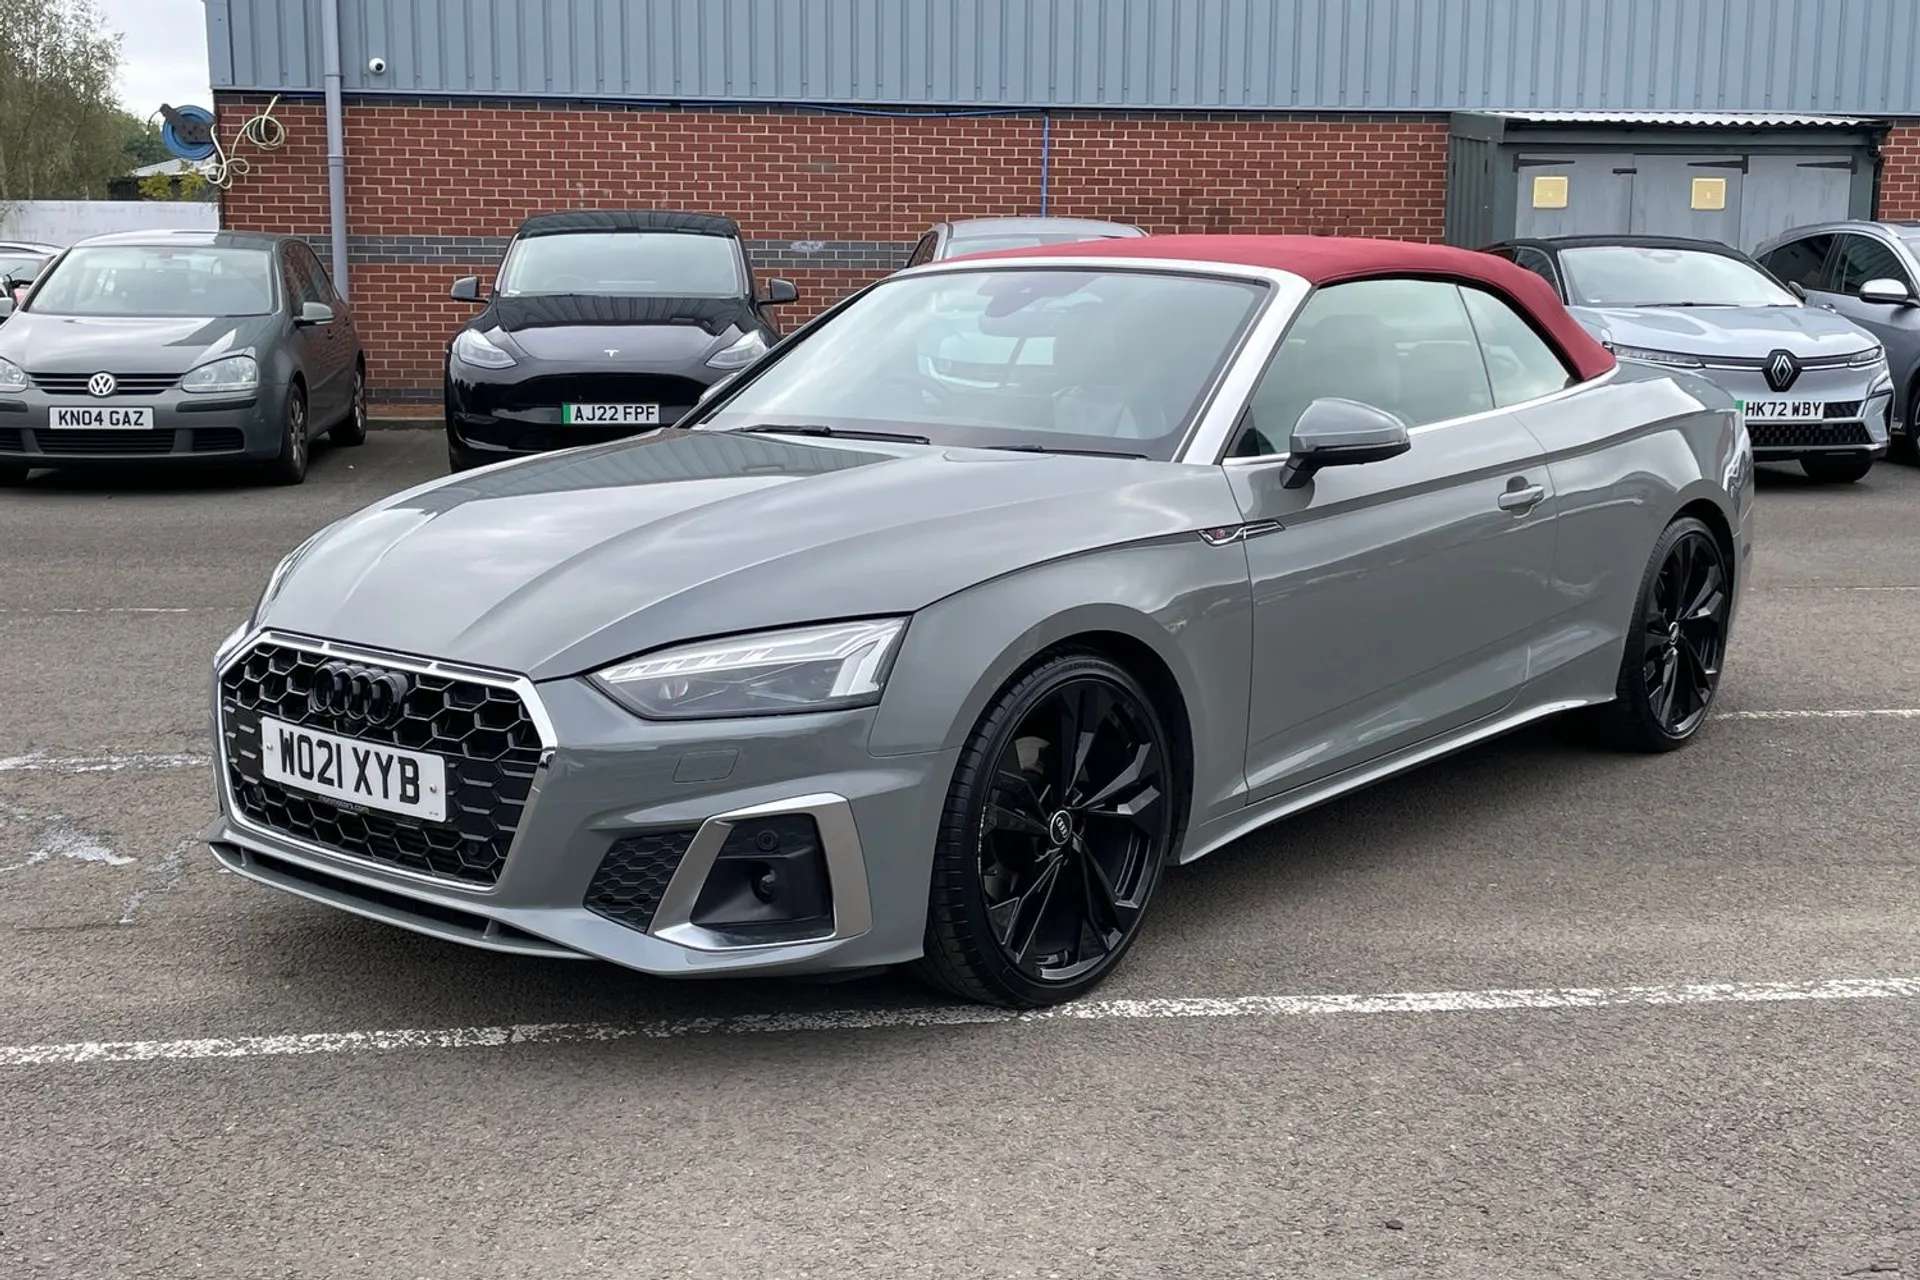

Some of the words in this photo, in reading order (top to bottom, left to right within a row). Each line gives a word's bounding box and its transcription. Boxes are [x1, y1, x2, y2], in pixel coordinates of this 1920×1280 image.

[58, 409, 104, 426] KN04
[109, 409, 144, 426] GAZ
[574, 405, 619, 422] AJ22
[623, 405, 656, 421] FPF
[1745, 402, 1787, 417] HK72
[1791, 402, 1822, 417] WBY
[279, 728, 343, 789] WO21
[351, 746, 420, 805] XYB
